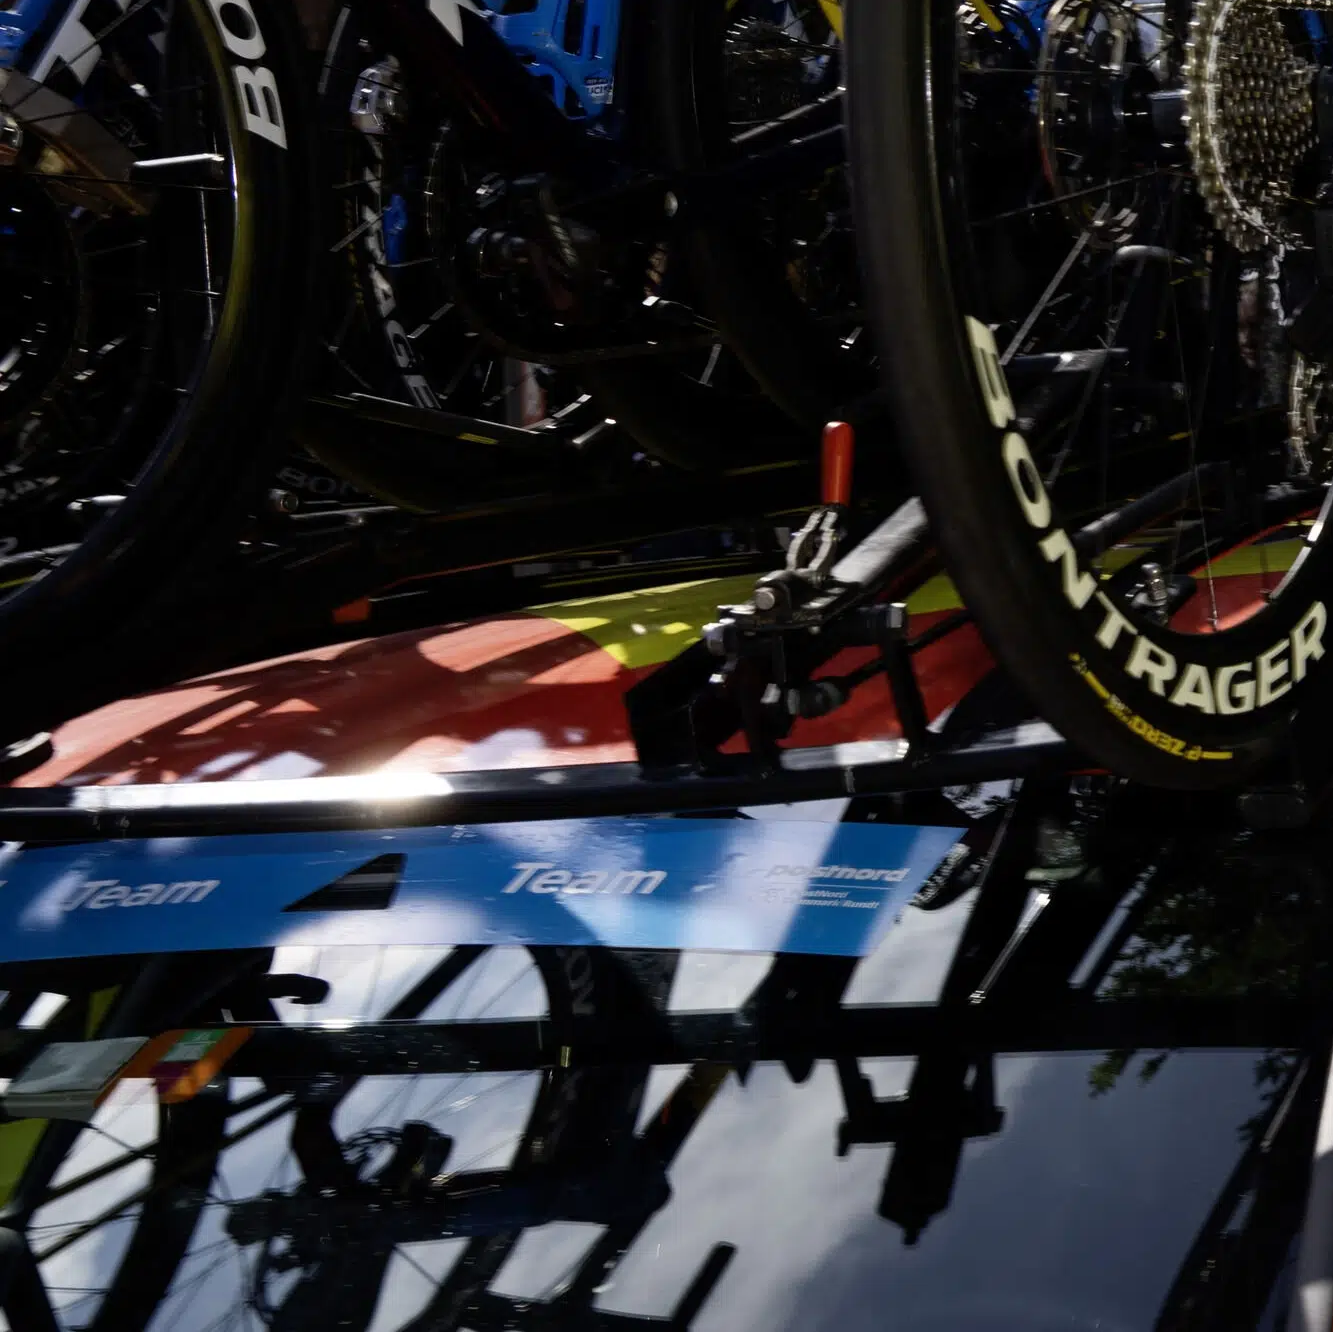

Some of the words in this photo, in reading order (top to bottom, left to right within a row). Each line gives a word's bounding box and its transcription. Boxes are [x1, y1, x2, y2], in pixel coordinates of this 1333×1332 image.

[964, 314, 1328, 716] BONTRAGER
[68, 877, 221, 912] Team
[499, 861, 669, 896] Team
